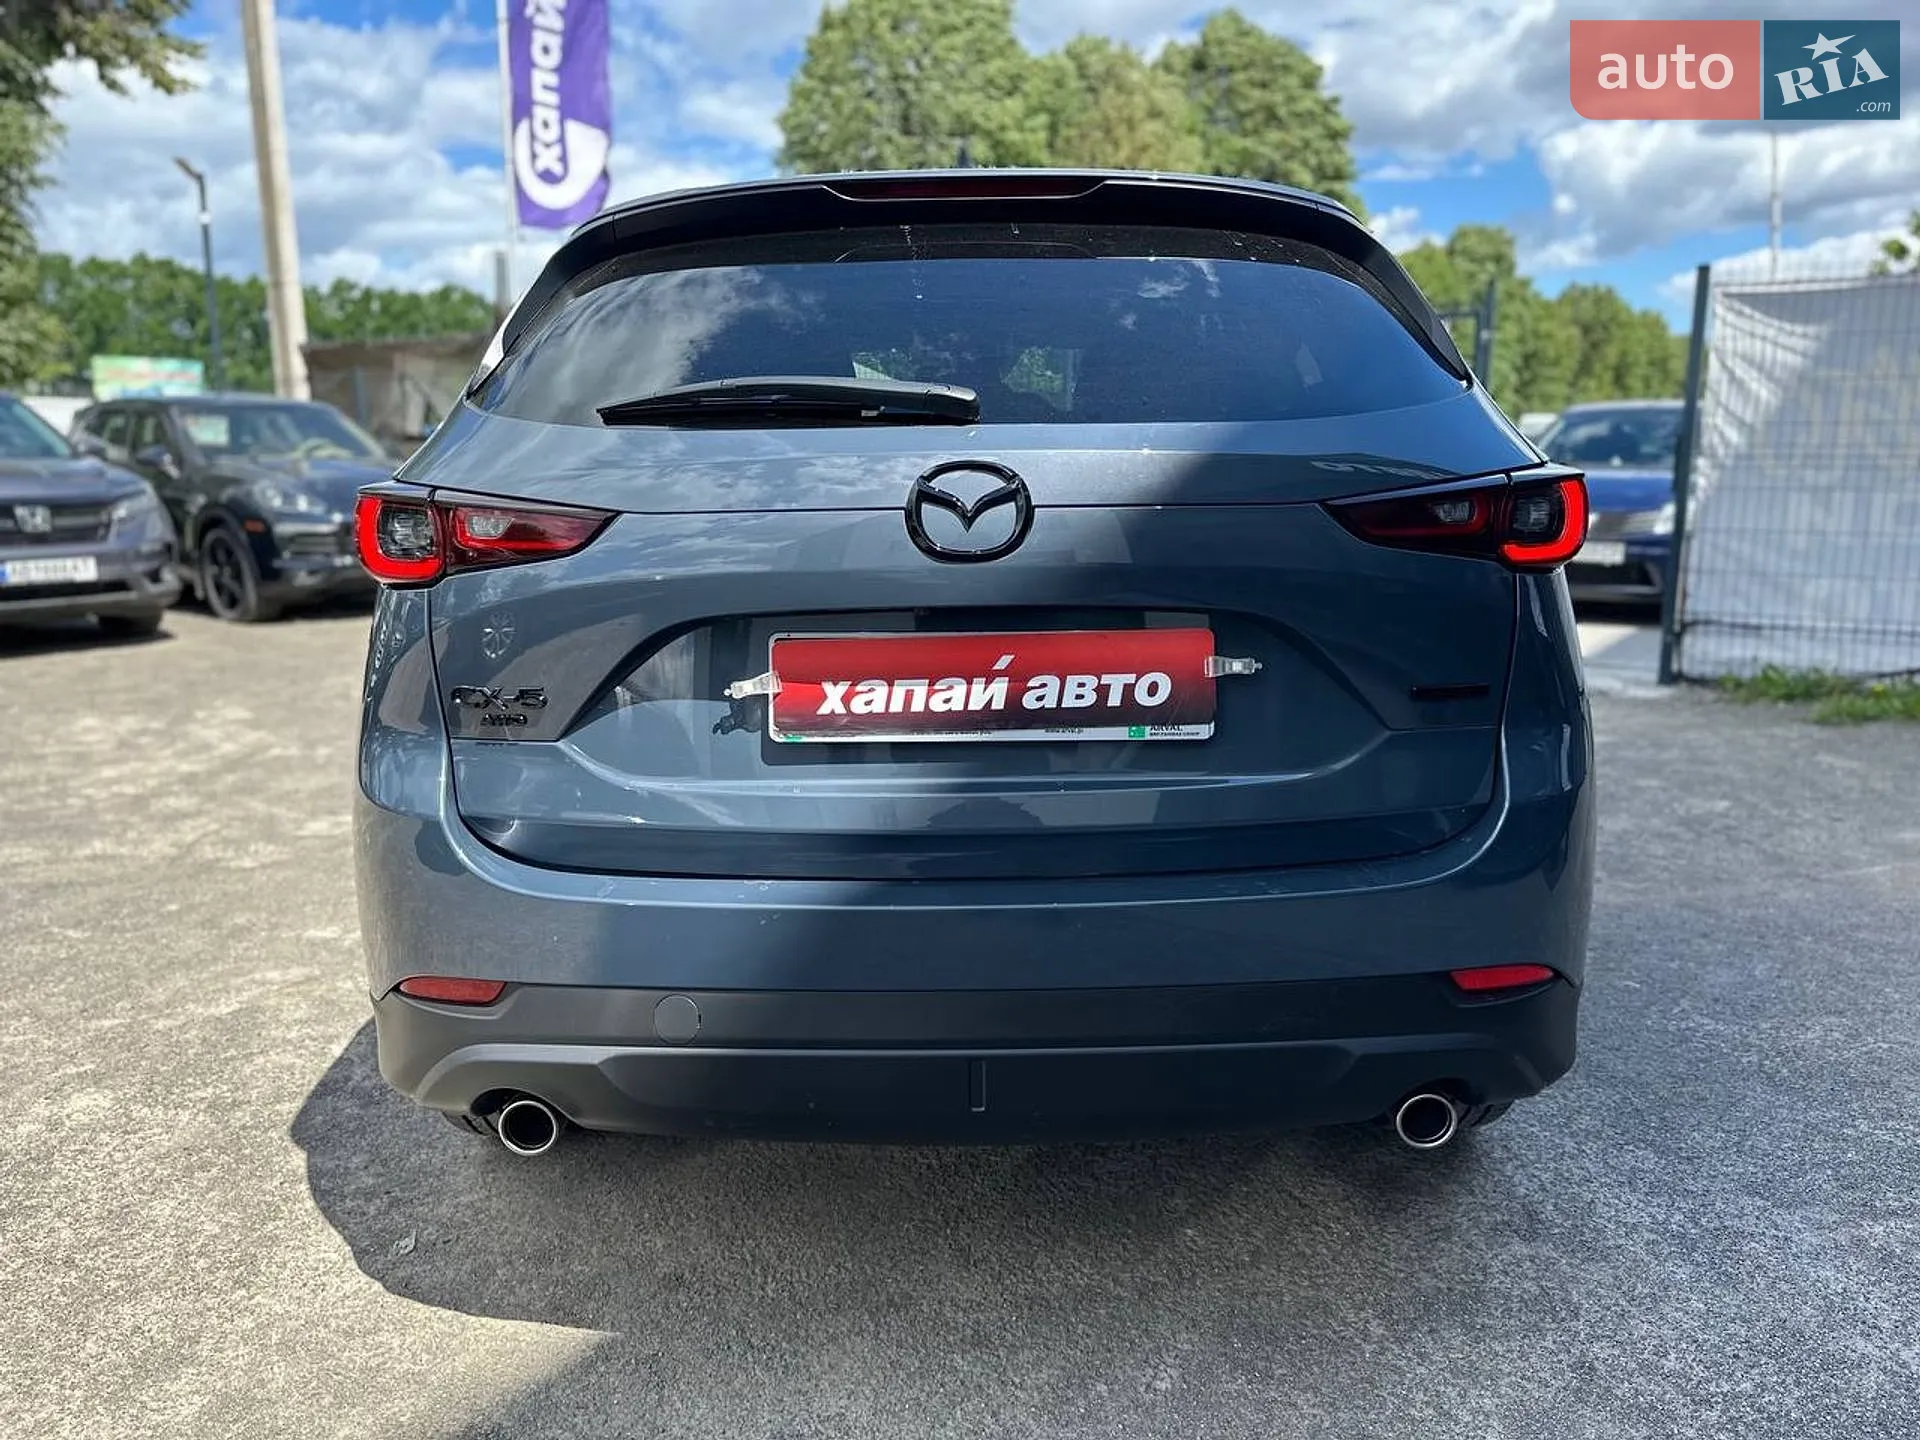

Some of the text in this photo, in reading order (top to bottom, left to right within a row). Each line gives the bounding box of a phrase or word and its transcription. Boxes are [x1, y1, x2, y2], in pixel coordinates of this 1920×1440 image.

[451, 685, 549, 709] CX-5
[816, 655, 1172, 715] хапай авто
